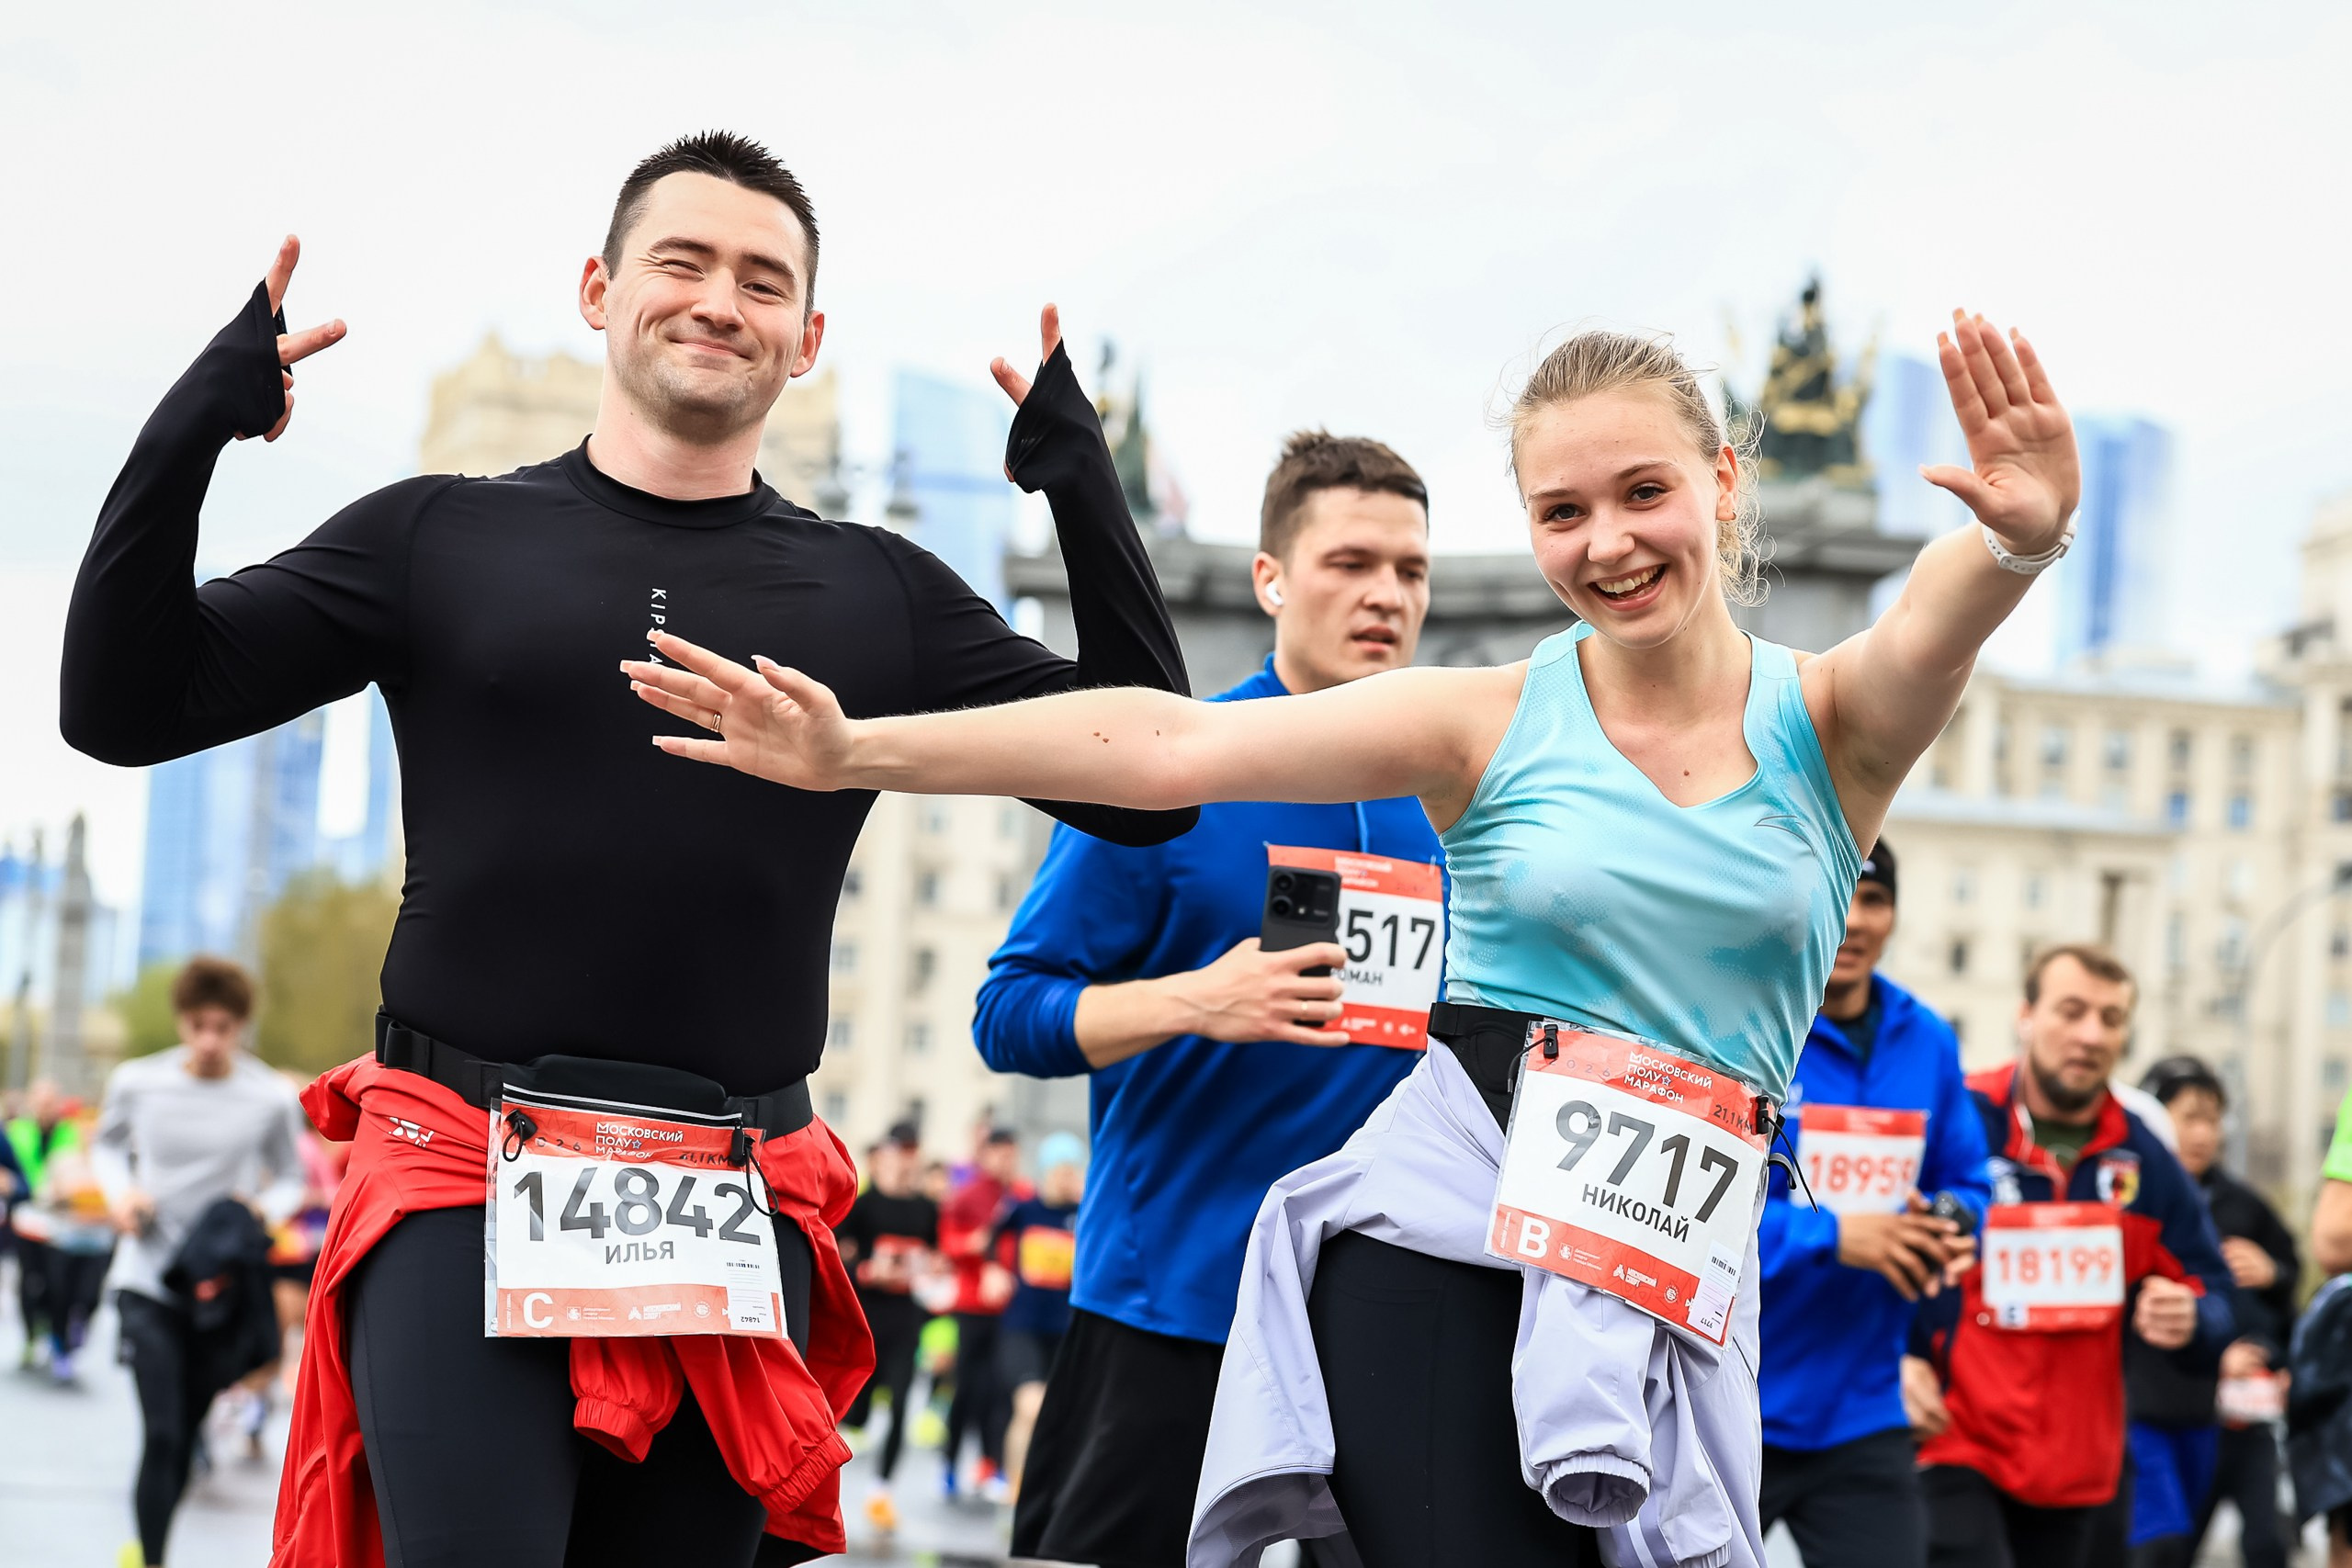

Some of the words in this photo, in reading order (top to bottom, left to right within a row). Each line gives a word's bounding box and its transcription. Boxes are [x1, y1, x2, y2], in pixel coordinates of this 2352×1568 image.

[650, 588, 667, 663] KIPA
[1623, 1075, 1684, 1103] МАРАФОН
[1626, 1063, 1661, 1081] ПОЛУ
[1628, 1051, 1713, 1089] МОСКОВСКИЙ
[595, 1122, 684, 1143] МОСКОВСКИЙ
[595, 1134, 632, 1147] ПОЛУ
[1555, 1100, 1739, 1224] 9717
[514, 1167, 761, 1246] 14842
[1581, 1183, 1690, 1243] НИКОЛАЙ
[605, 1241, 675, 1265] ИЛЬЯ
[1996, 1247, 2115, 1285] 18199
